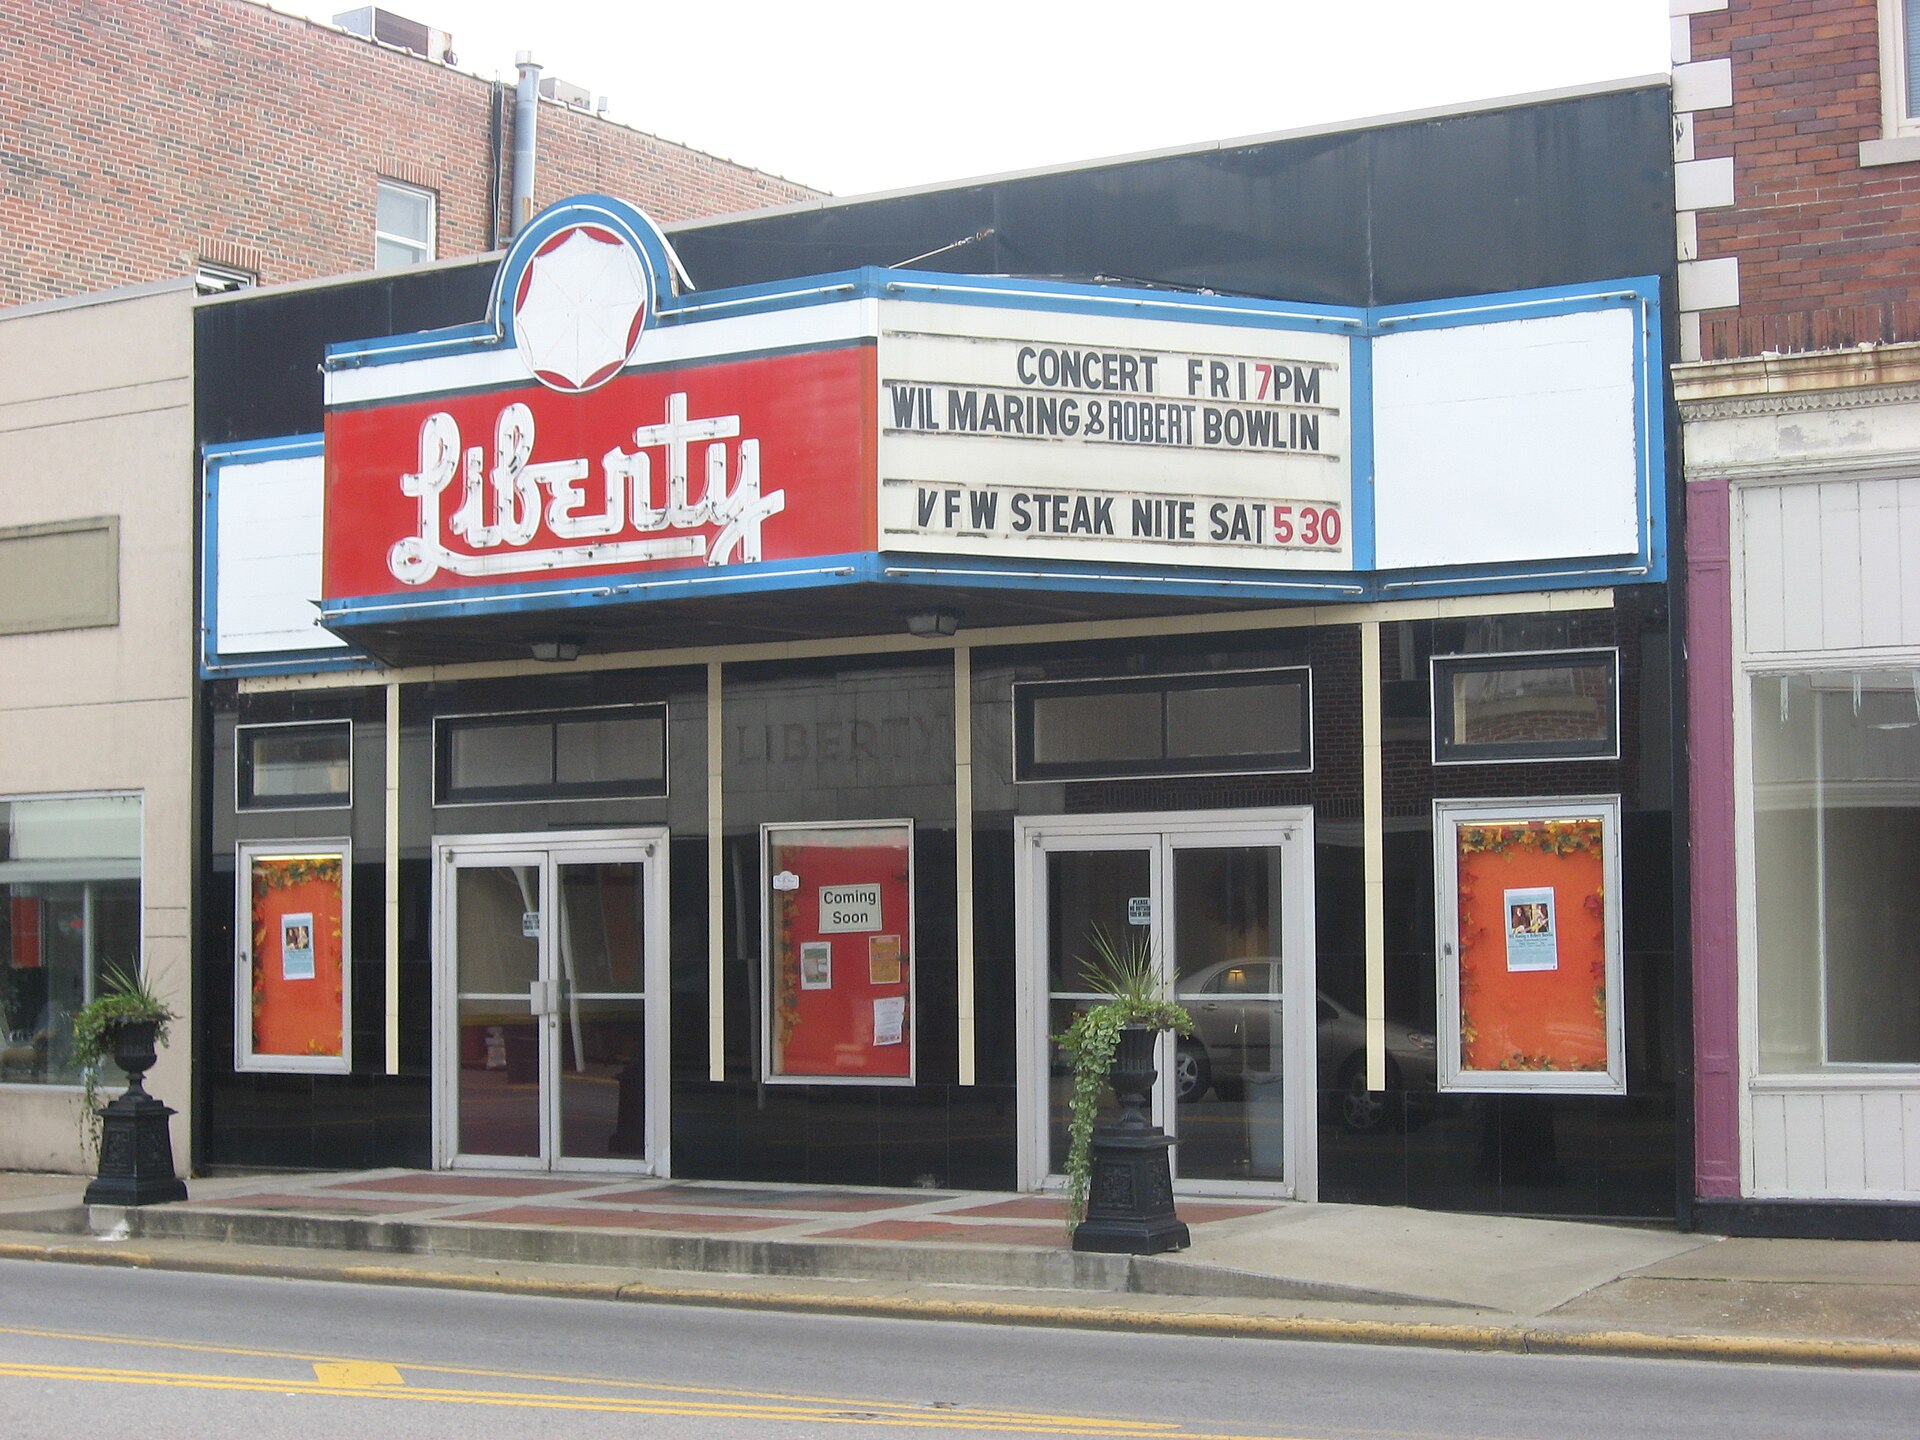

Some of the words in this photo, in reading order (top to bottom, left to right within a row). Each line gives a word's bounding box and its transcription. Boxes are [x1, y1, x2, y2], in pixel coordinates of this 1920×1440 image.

[1017, 347, 1157, 393] CONCERT
[1188, 359, 1245, 401] FRI
[892, 386, 939, 430] WIL
[948, 390, 1078, 437] MARING
[1109, 399, 1196, 445] ROBERT
[1204, 408, 1320, 451] BOWLIN
[387, 392, 785, 584] Liberty
[918, 487, 997, 530] VFW
[1012, 493, 1113, 536] STEAK
[1132, 499, 1195, 540] NITE
[1210, 503, 1265, 544] SAT
[736, 714, 948, 765] LIBERTY
[824, 891, 876, 905] Coming
[833, 911, 868, 925] Soon
